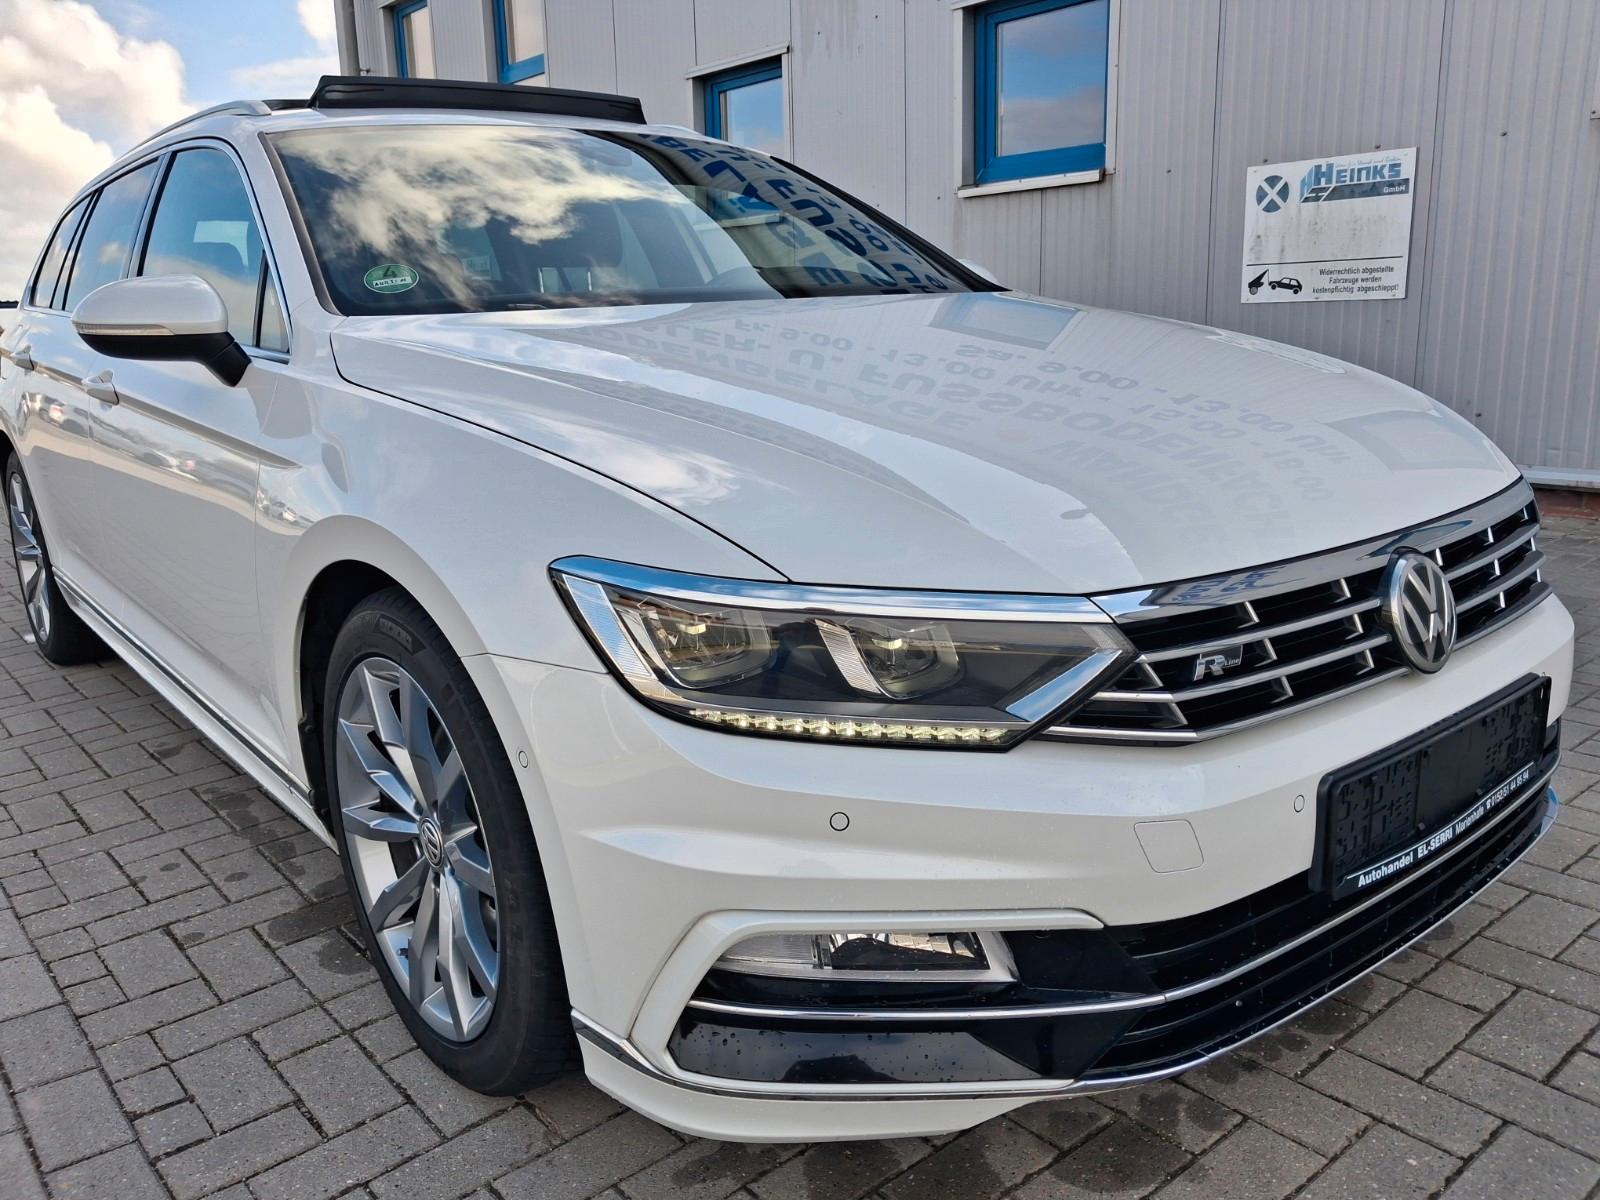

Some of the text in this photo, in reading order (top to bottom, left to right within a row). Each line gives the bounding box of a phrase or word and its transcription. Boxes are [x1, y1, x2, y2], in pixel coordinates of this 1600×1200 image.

[1383, 184, 1406, 194] GmbH
[1319, 265, 1395, 276] Widerrechtlich abgestellte
[1328, 275, 1382, 285] Fahrzeuge werden
[1312, 285, 1354, 295] kostenpflichtig
[1358, 851, 1413, 888] Autohandel
[1417, 827, 1453, 859] EL-SERRI
